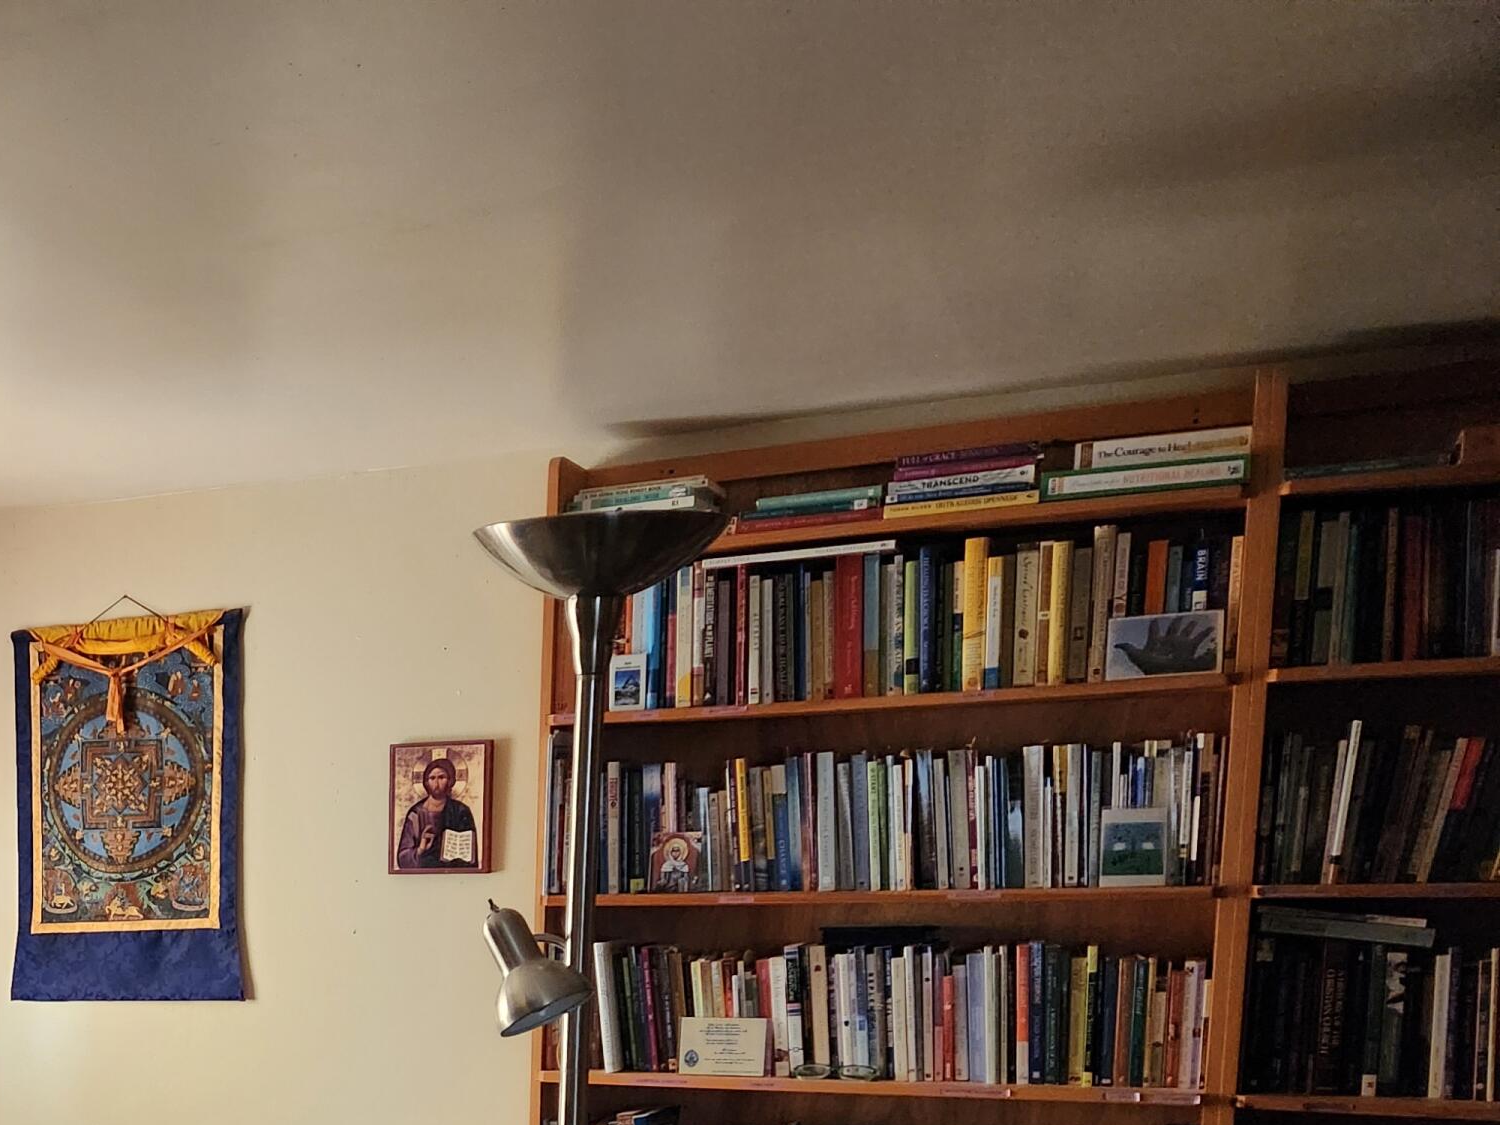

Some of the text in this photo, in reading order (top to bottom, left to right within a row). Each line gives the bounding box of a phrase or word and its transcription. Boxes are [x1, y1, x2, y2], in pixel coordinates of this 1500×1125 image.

[1114, 447, 1155, 457] Courage
[921, 476, 979, 489] TRANSCEND
[1195, 548, 1206, 580] BRAIN
[1319, 968, 1335, 1054] CHRISTIAN CHURCH
